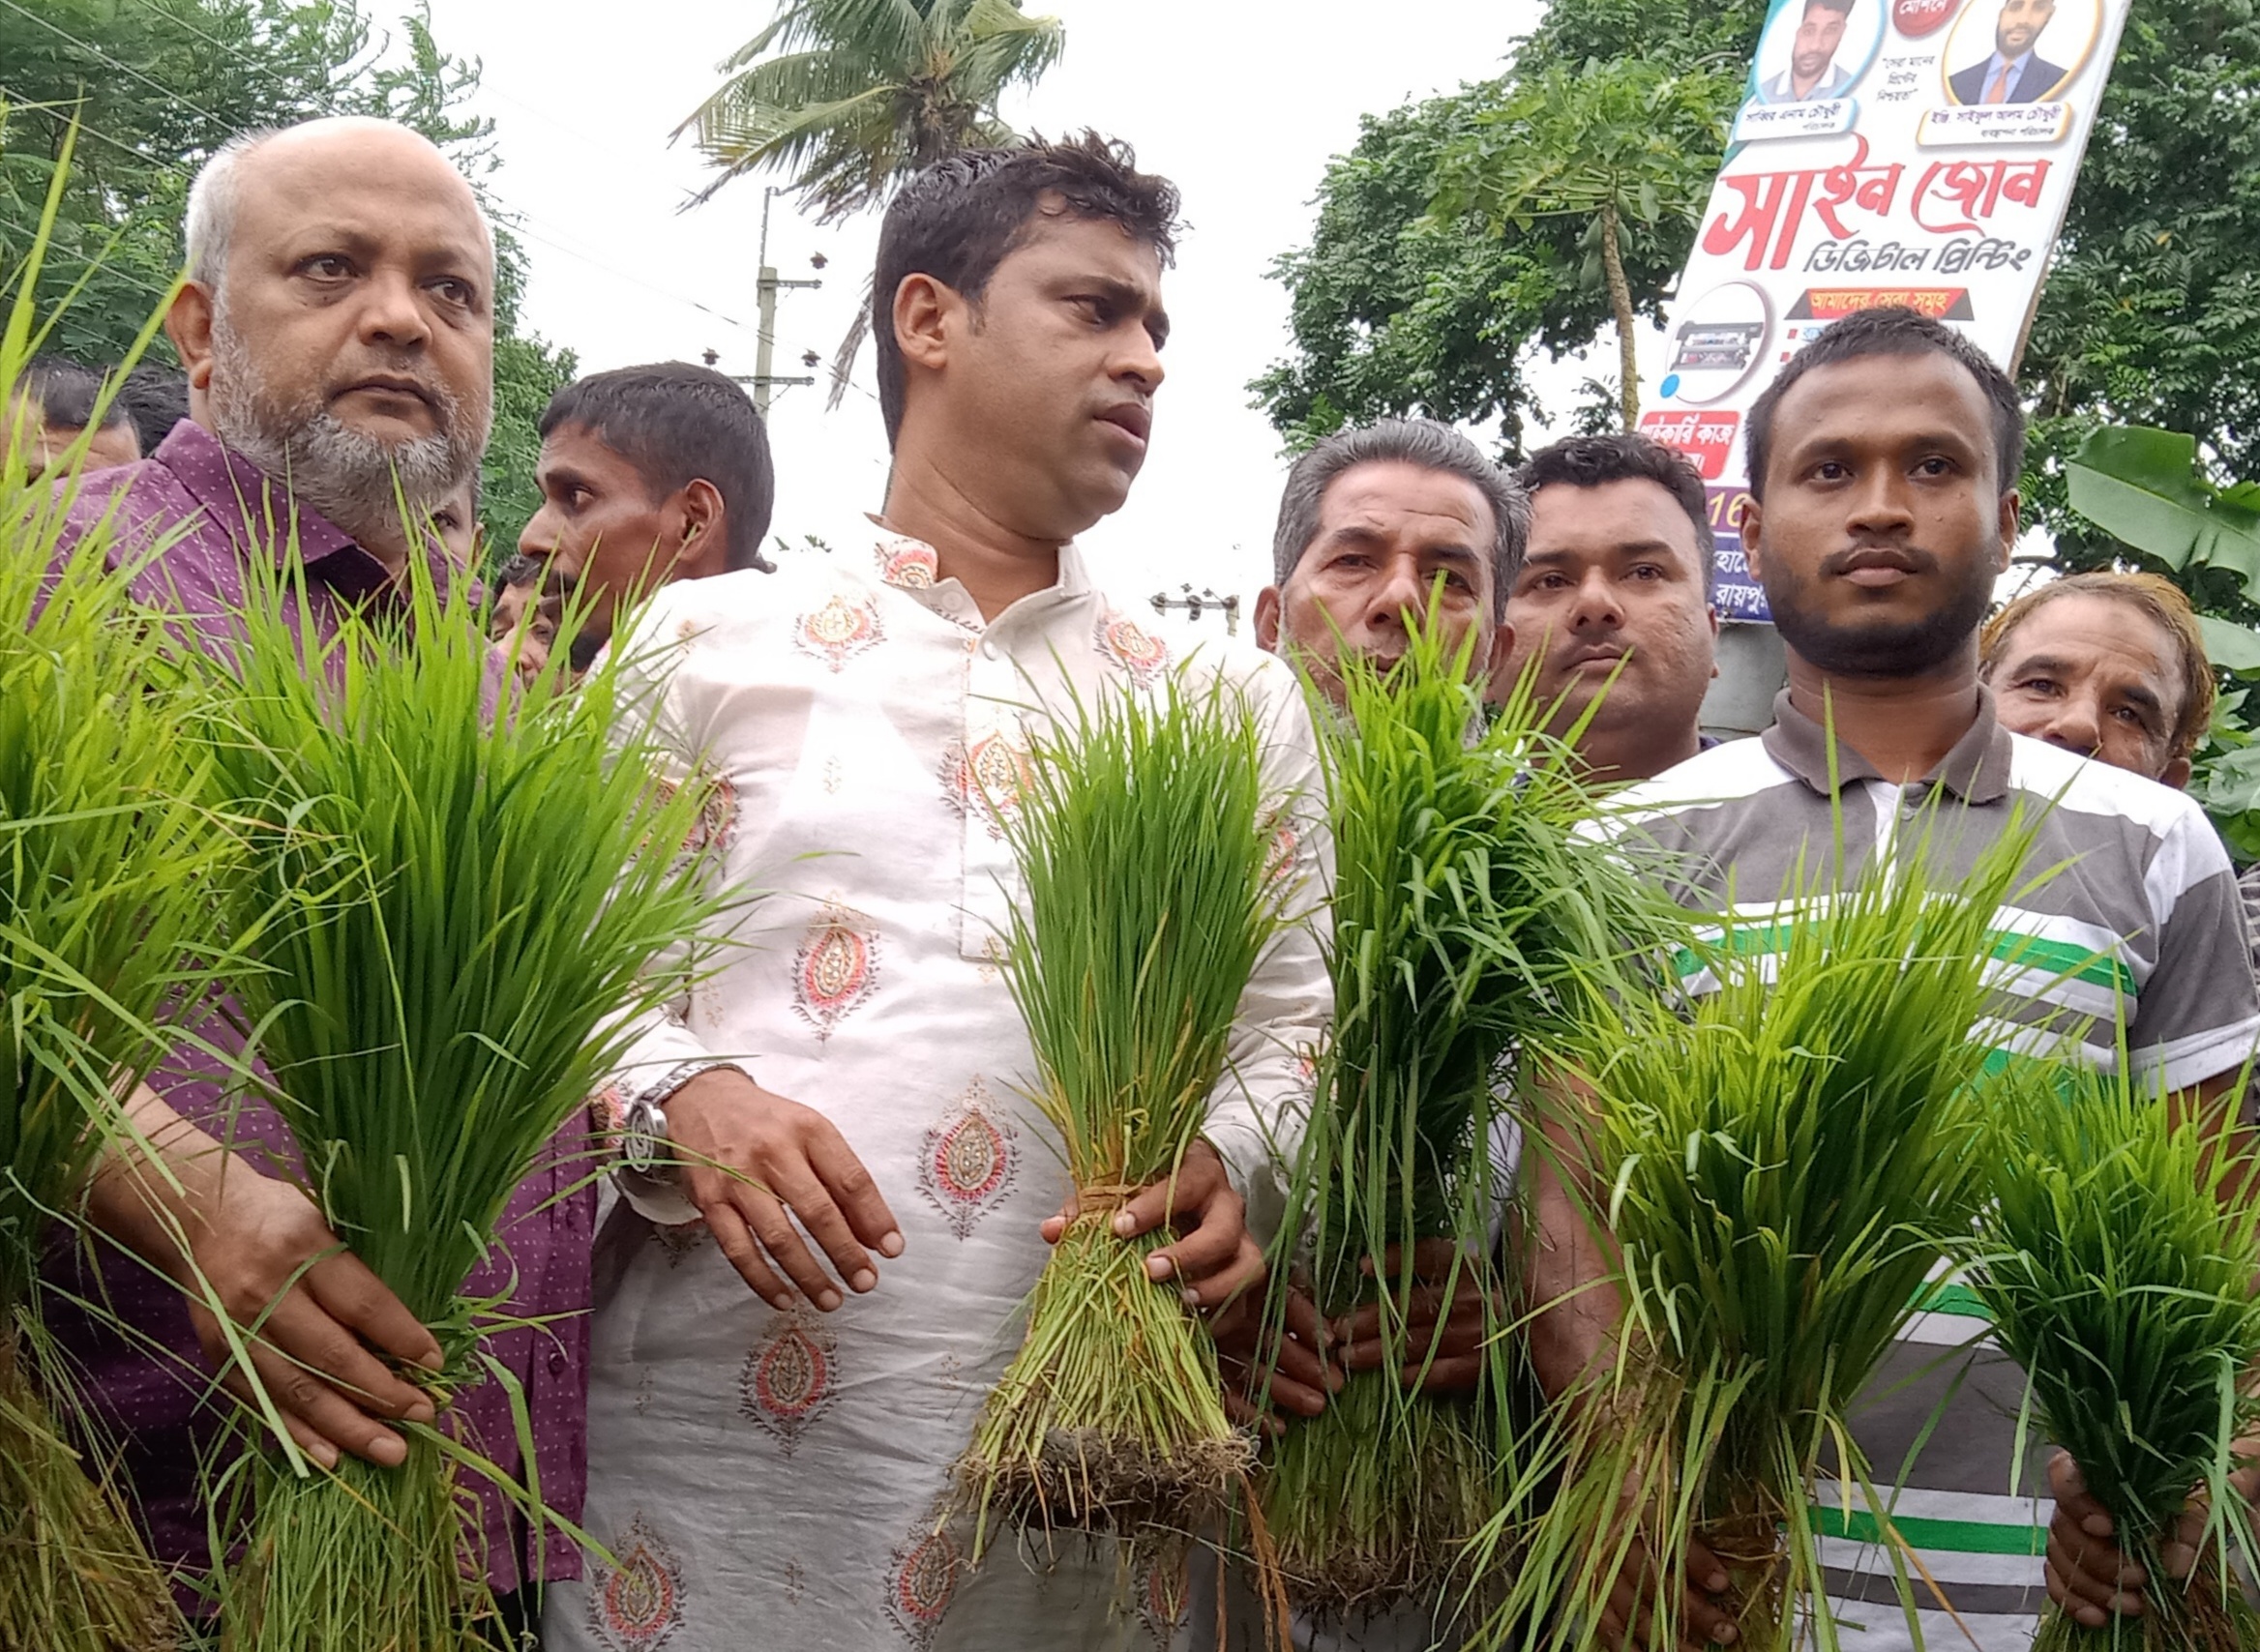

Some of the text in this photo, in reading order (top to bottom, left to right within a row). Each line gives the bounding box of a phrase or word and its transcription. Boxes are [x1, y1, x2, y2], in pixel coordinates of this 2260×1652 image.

[1808, 102, 1841, 119] চৌধুরী
[1996, 109, 2024, 121] আলম
[2027, 104, 2061, 122] চৌধুরী
[2019, 125, 2055, 136] পরিচালক
[1702, 132, 2053, 271] সাইন জোন
[1802, 238, 2031, 274] ডিজিটাল প্রিন্টিং
[1810, 291, 1870, 310] আমাদের
[1874, 291, 1910, 309] সেবা
[1696, 424, 1735, 445] কাজ
